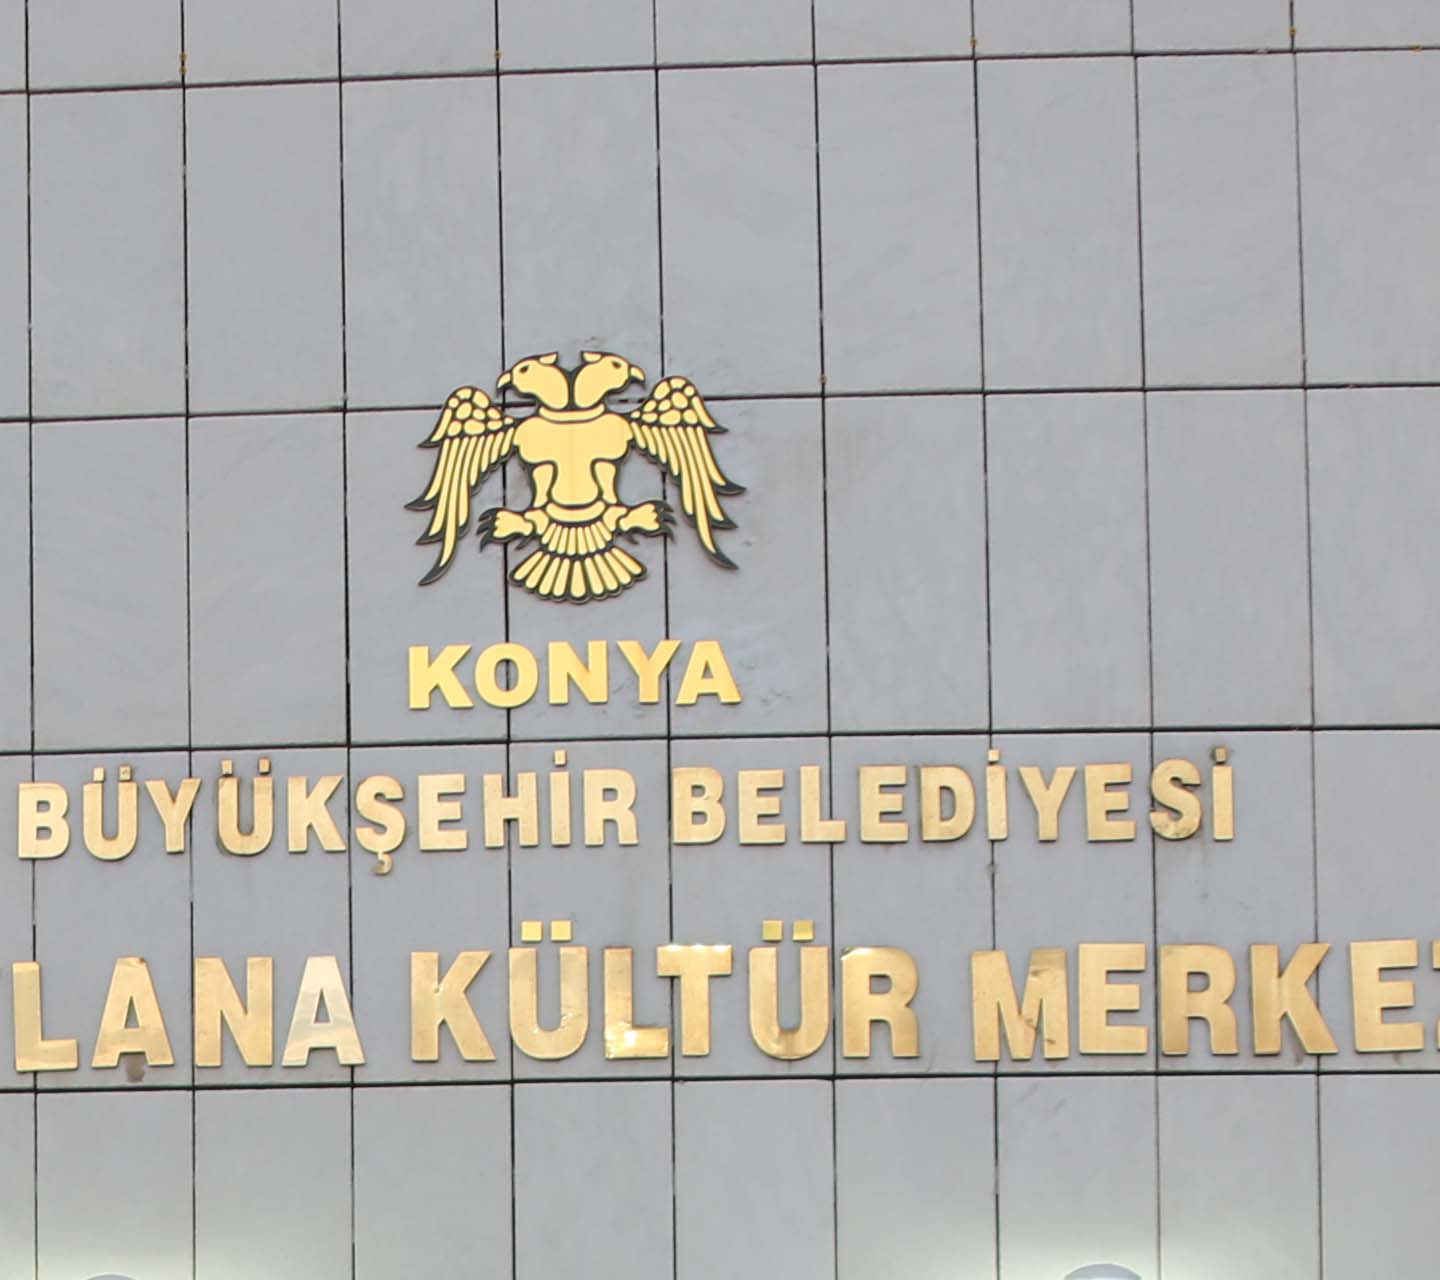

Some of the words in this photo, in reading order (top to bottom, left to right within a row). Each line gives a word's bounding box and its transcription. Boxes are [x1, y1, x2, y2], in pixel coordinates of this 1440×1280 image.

[409, 639, 742, 710] KONYA
[18, 749, 640, 874] BÜYÜKŞEHİR
[672, 746, 1235, 845] BELEDİYESİ
[411, 919, 919, 1062] KÜLTÜR
